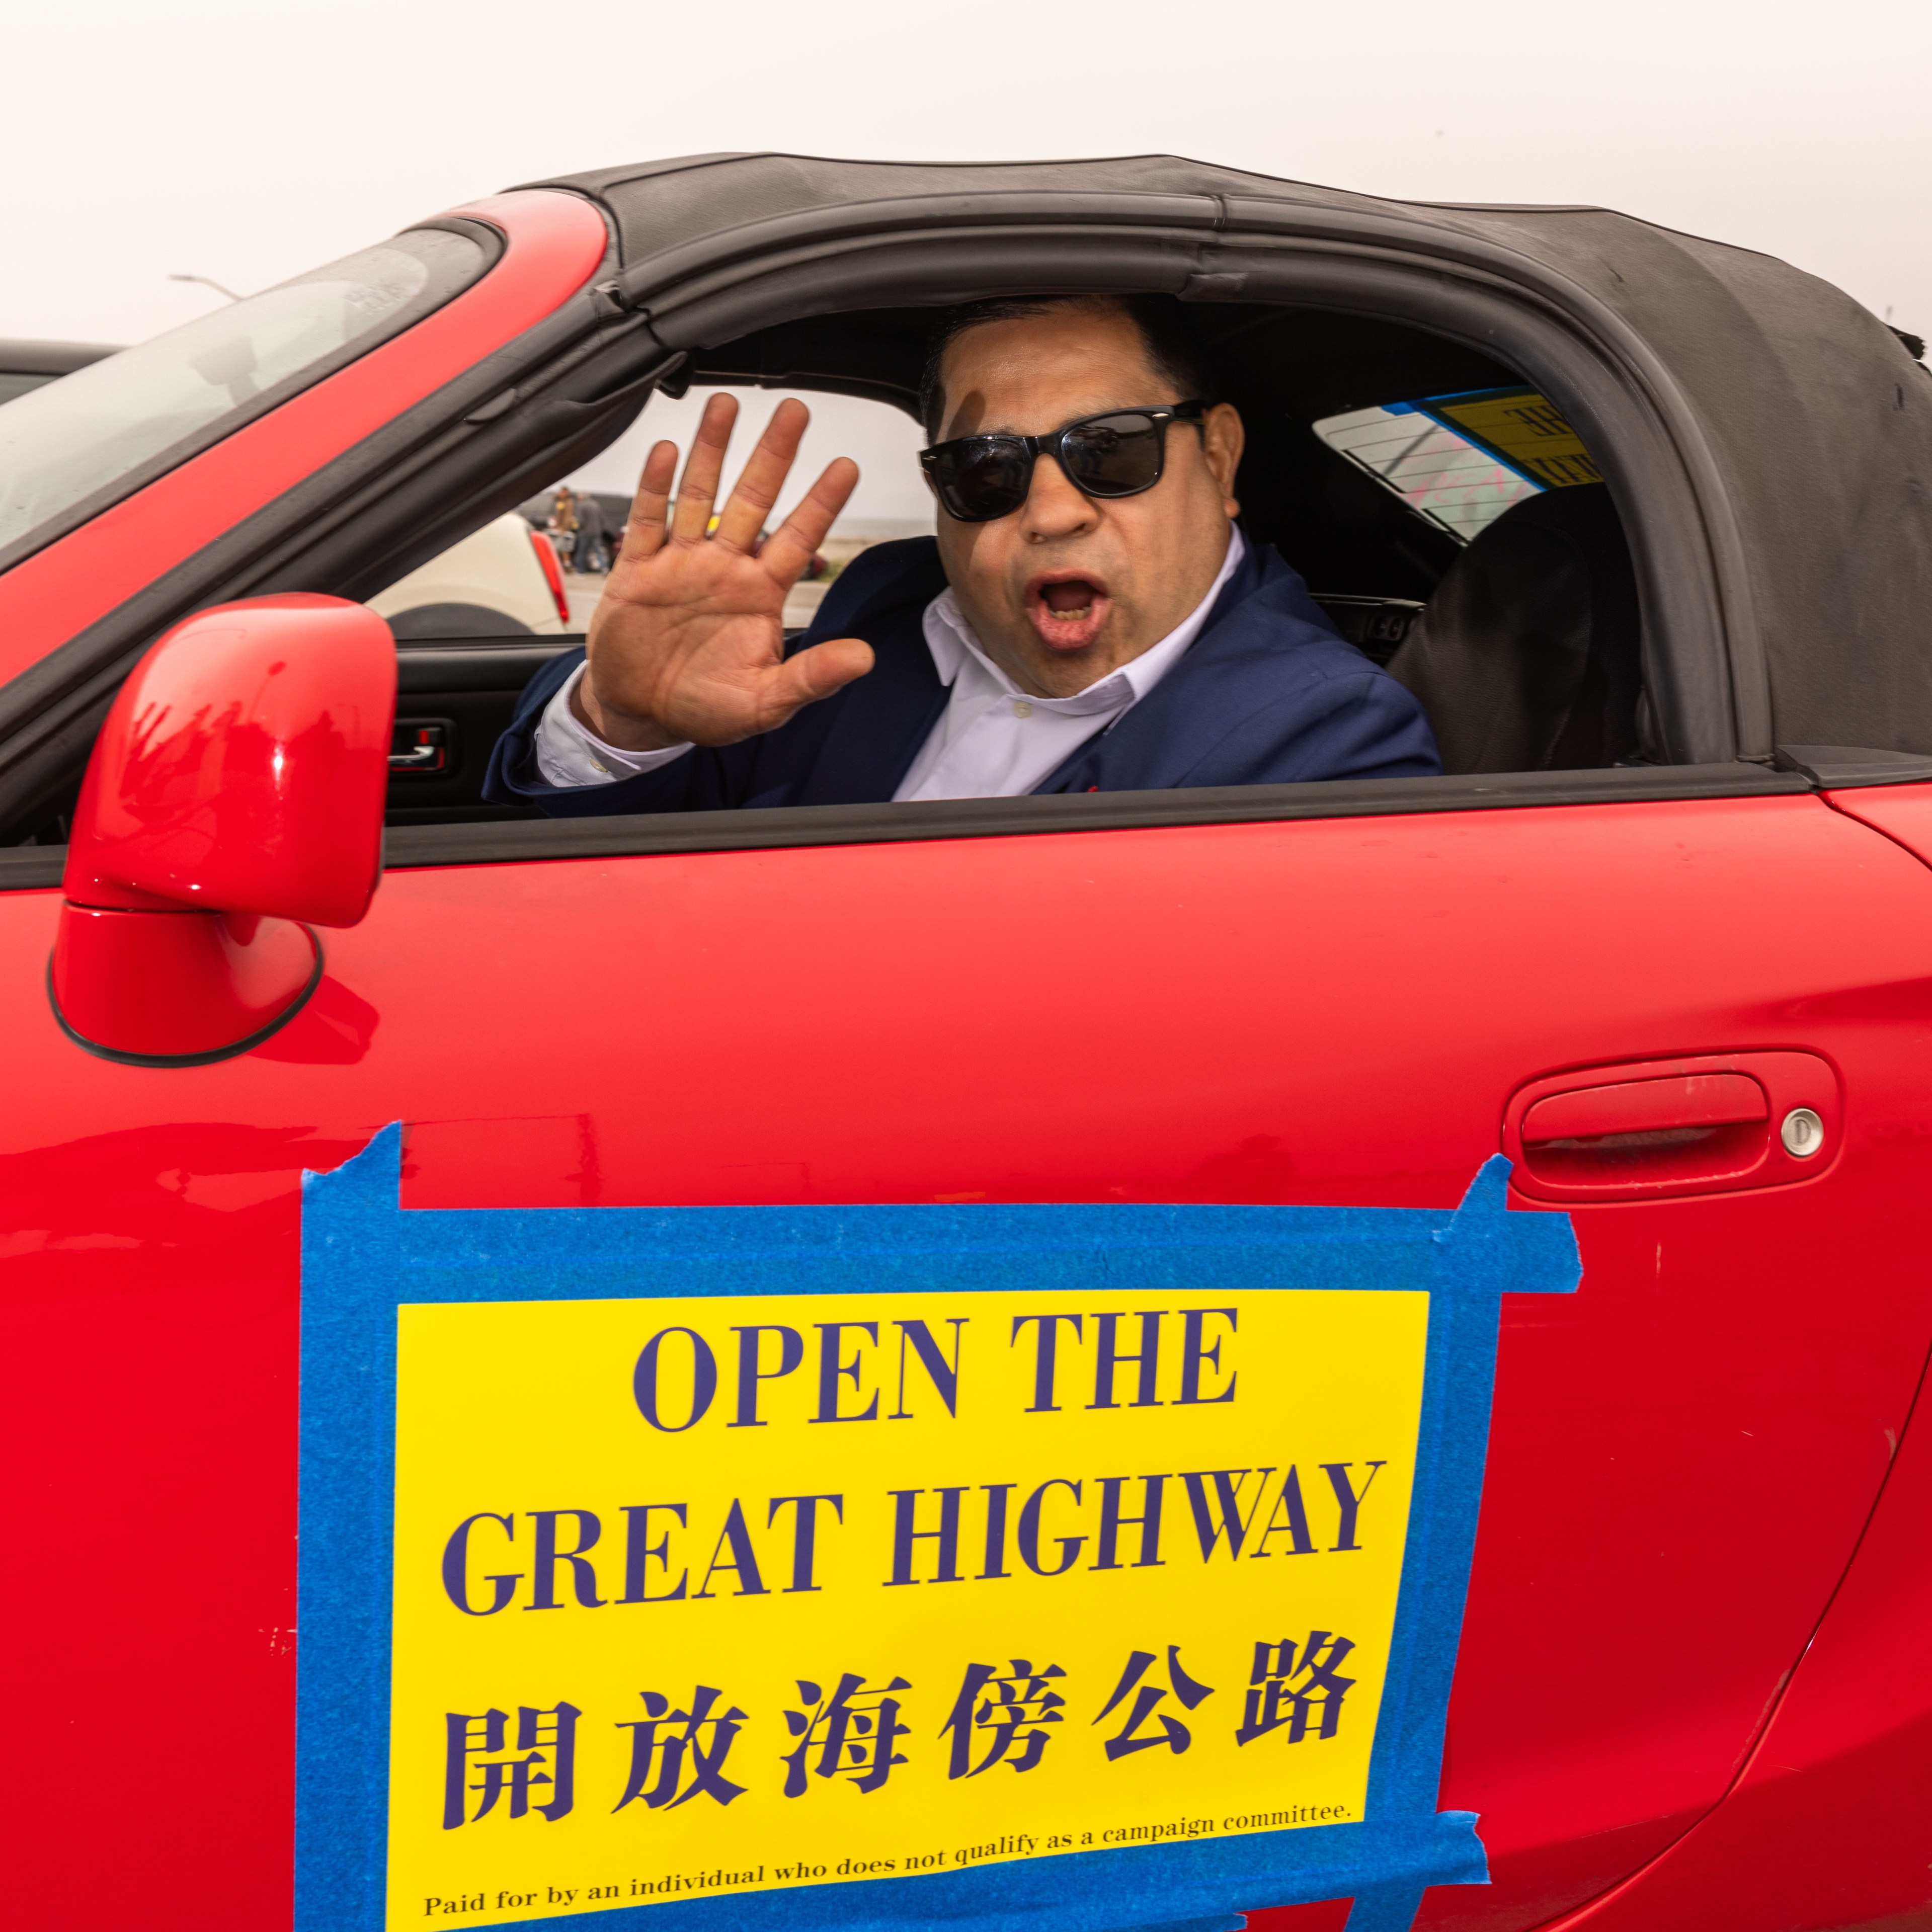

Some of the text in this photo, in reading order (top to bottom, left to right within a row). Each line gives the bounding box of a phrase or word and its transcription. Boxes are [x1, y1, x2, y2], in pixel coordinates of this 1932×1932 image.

[633, 1307, 1238, 1433] OPEN THE
[441, 1460, 1388, 1617] GREAT HIGHWAY
[442, 1630, 1357, 1831] 開放海傍公路
[424, 1803, 1352, 1916] Paid for by an individual who does not qualify as a campaign committee.
